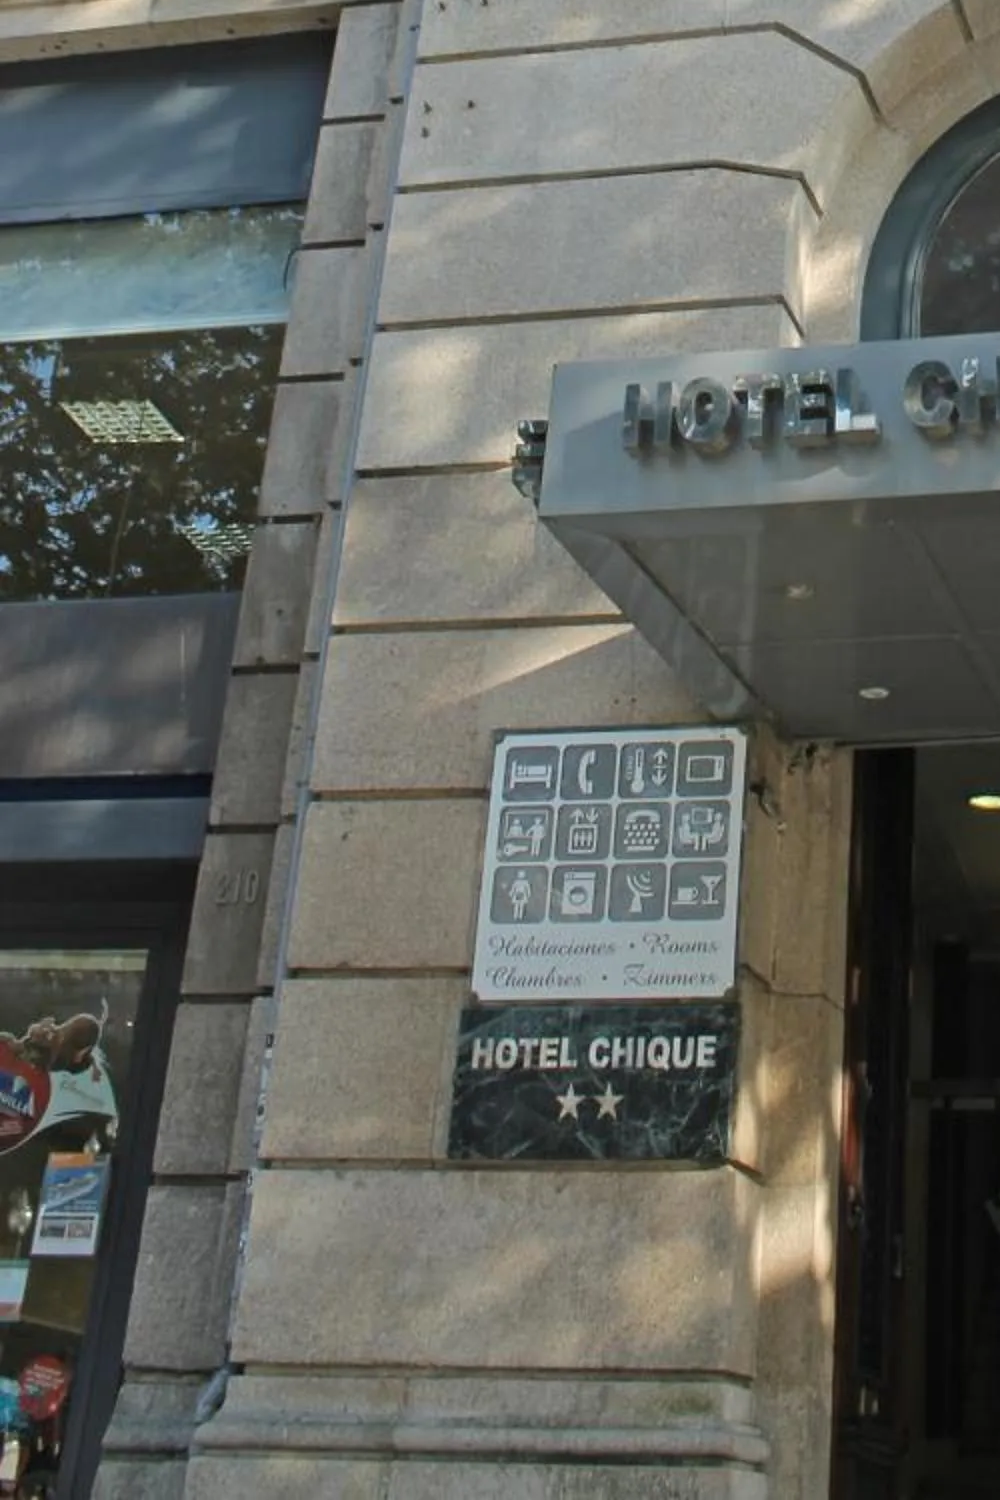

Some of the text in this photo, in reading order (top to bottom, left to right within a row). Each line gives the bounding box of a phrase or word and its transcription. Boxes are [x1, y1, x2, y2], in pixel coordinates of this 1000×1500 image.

[622, 368, 882, 453] HOTEL
[489, 931, 719, 957] Habitaciones Rooms
[486, 963, 719, 989] Chambres Zimmers
[471, 1035, 717, 1071] HOTEL CHIQUE
